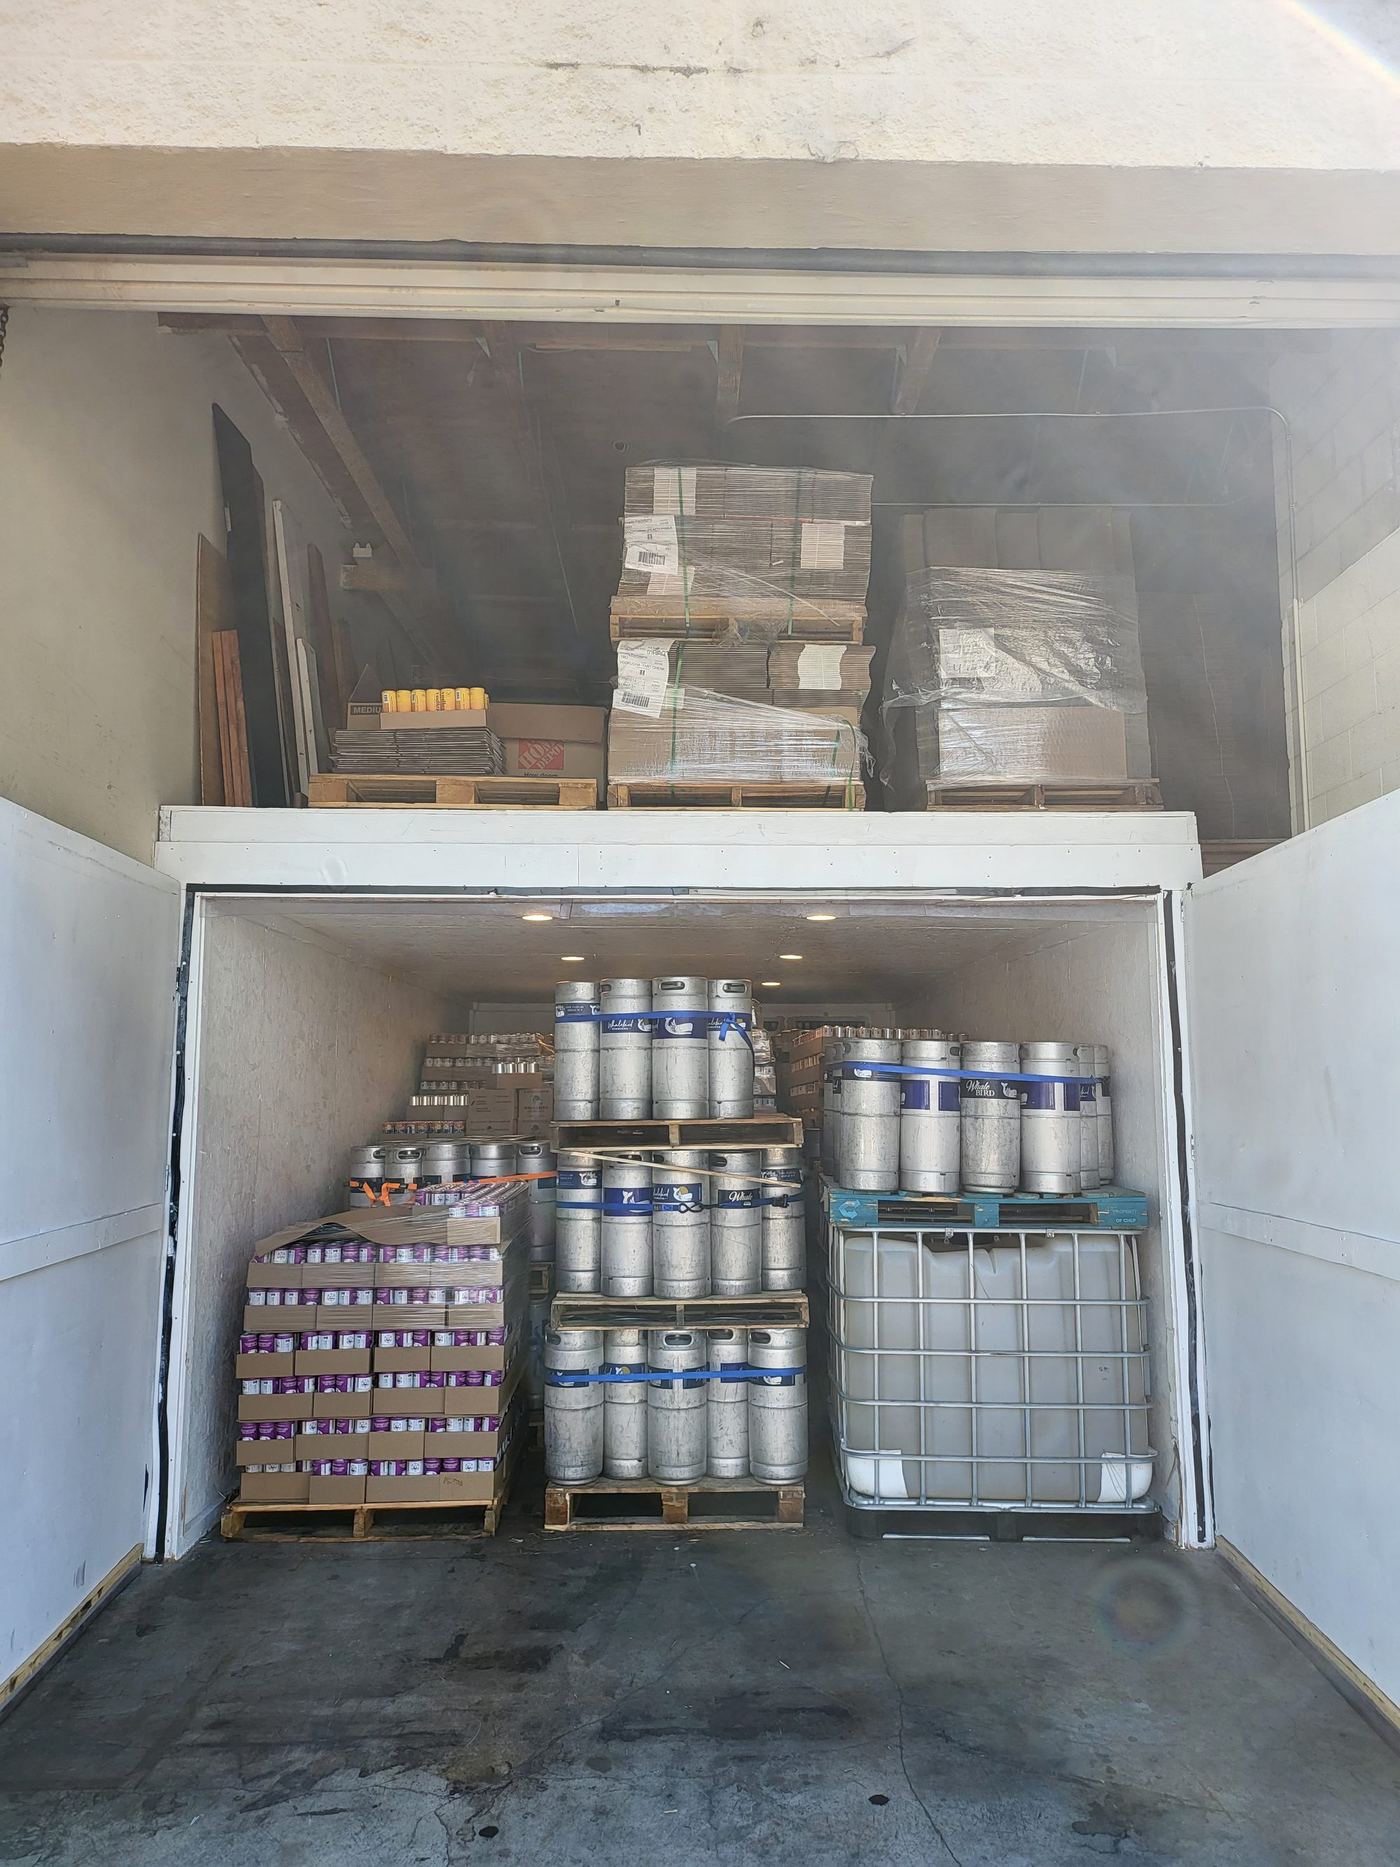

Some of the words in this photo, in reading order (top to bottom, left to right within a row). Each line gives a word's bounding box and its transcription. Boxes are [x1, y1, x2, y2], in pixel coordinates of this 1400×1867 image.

[353, 706, 381, 714] MEDIU
[966, 1079, 990, 1092] Whale
[975, 1089, 995, 1097] BIRD
